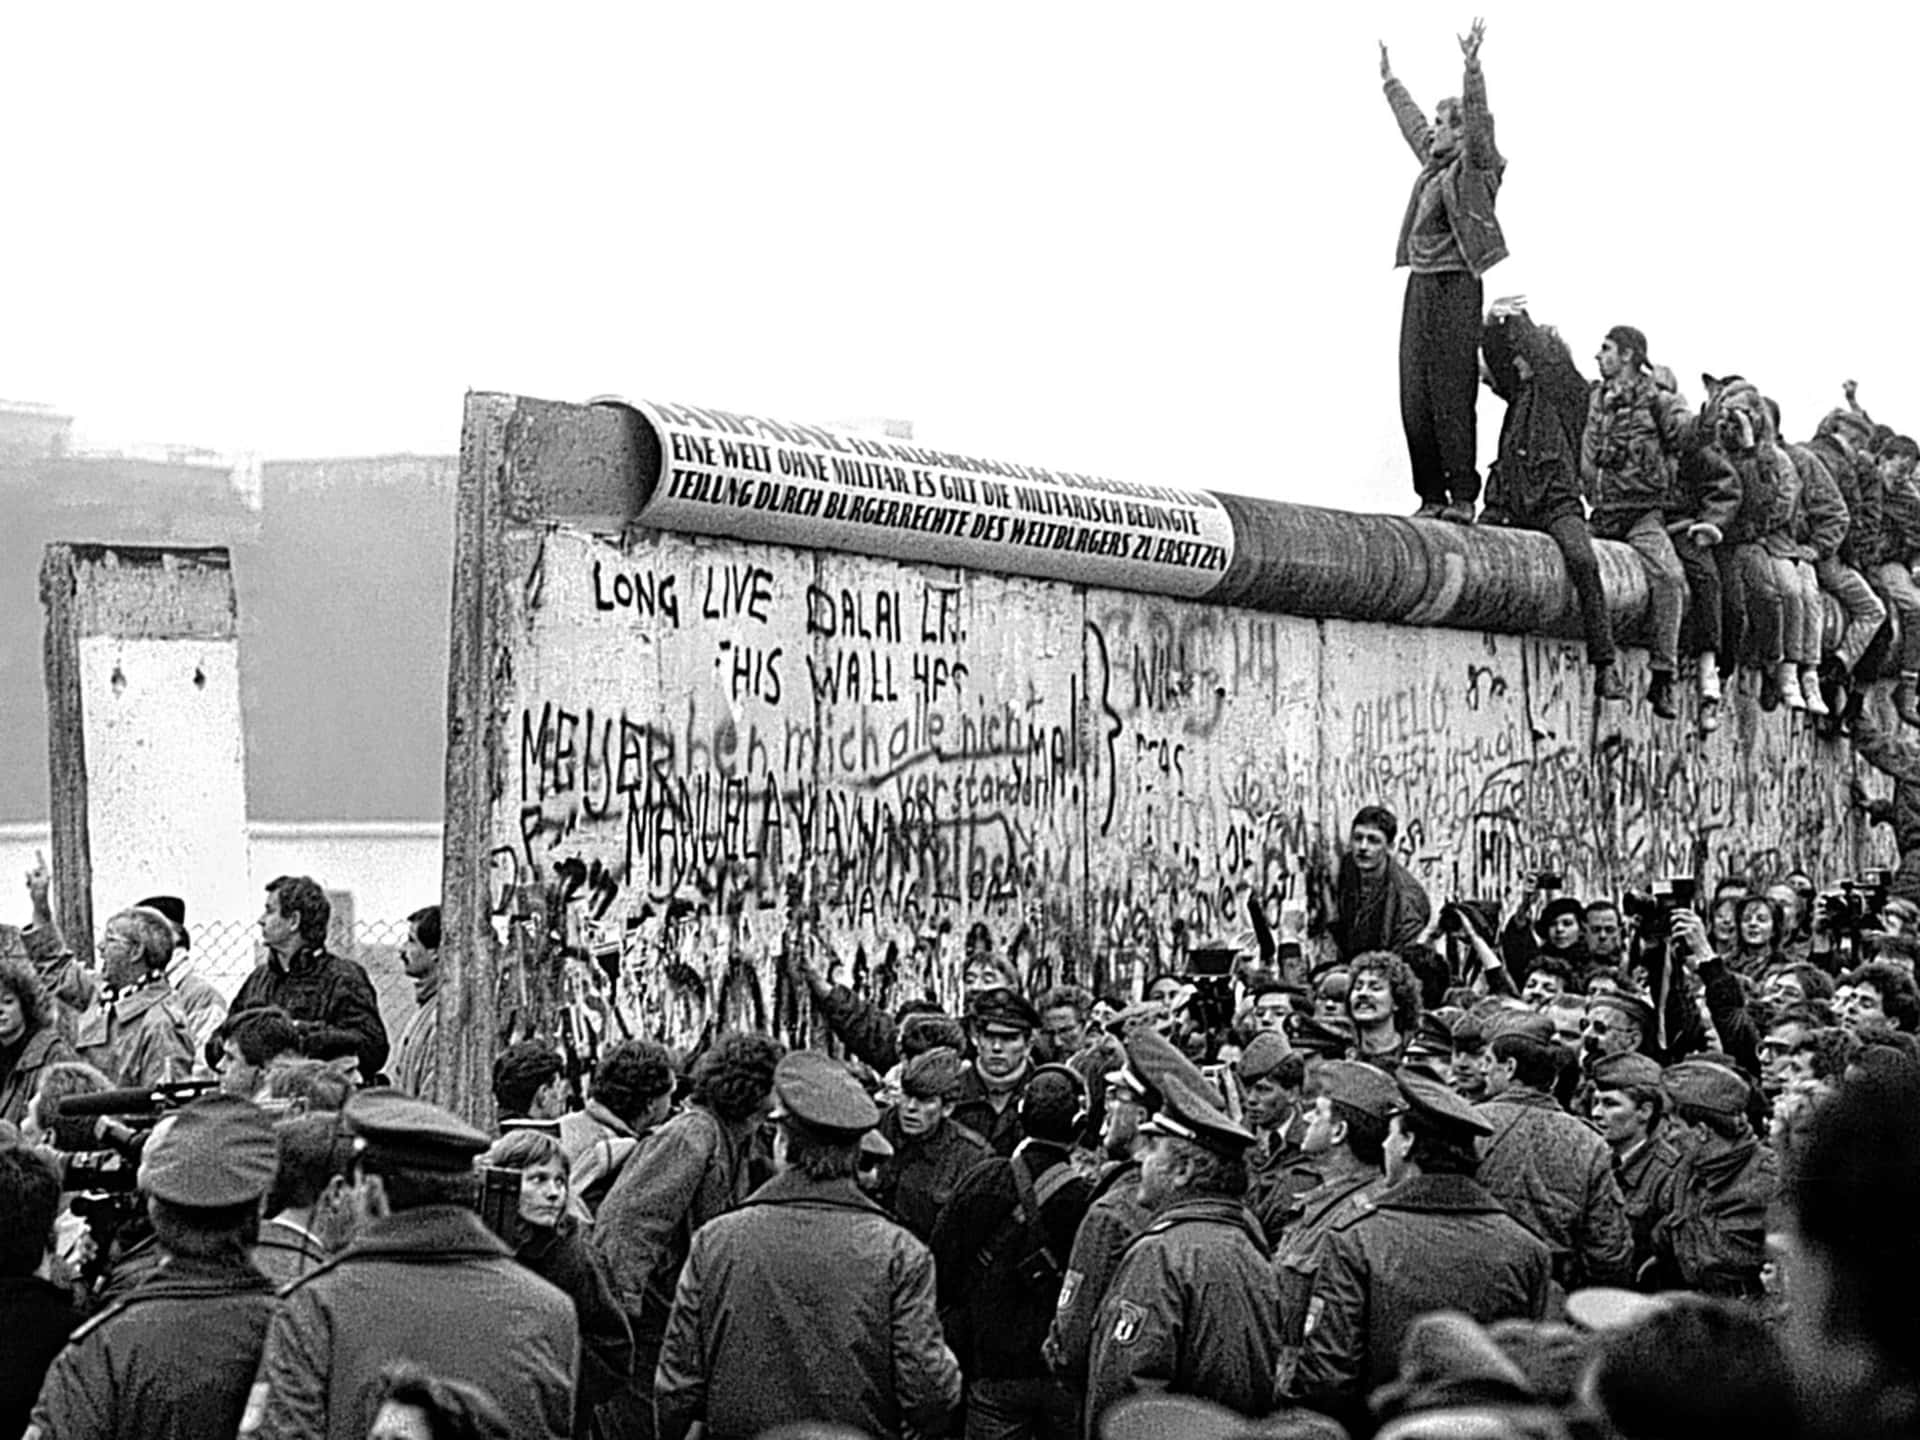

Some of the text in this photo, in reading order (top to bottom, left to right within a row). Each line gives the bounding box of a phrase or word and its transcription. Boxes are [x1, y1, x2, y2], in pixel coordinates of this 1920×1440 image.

[669, 432, 718, 466] EINE
[719, 438, 771, 474] WELT
[778, 448, 829, 482] OHNE
[912, 470, 936, 498] ES
[940, 474, 977, 504] GILT
[981, 480, 1012, 509] DIE
[969, 513, 1009, 542] DES
[1154, 538, 1228, 572] ERSETZEN
[593, 560, 680, 629] LONG
[703, 563, 774, 625] LIVE
[806, 583, 901, 643] DALAI
[806, 648, 898, 705] WALL
